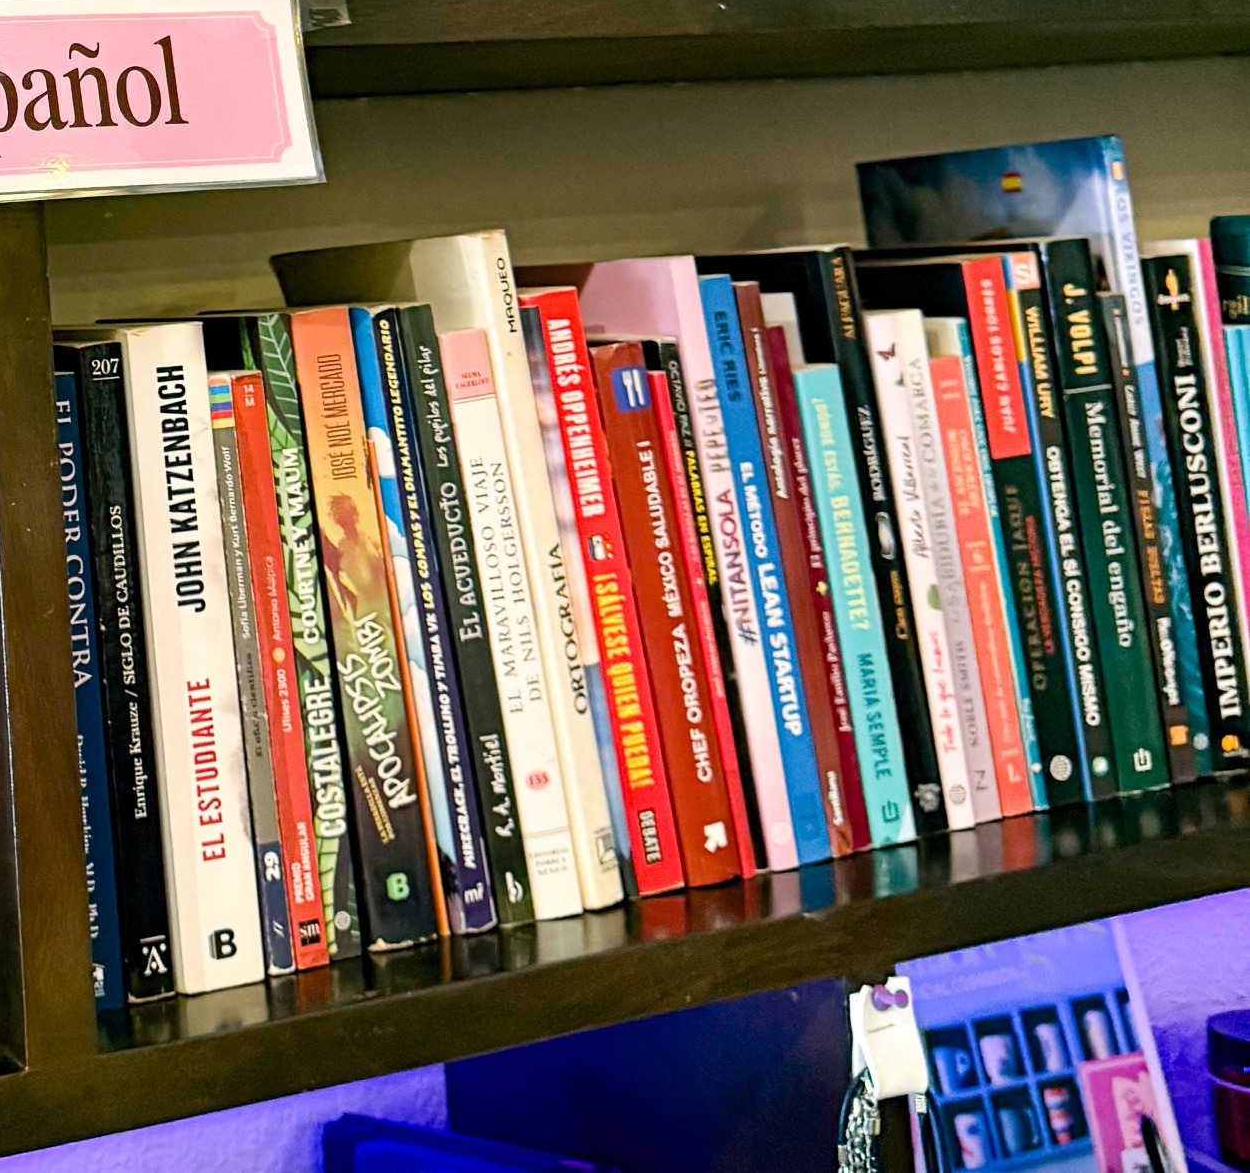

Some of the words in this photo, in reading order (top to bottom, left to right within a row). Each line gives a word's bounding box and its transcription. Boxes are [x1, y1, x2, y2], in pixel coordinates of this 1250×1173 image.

[91, 358, 120, 374] 207
[547, 319, 578, 387] ANDRÉS
[1067, 310, 1098, 375] VOLPI
[156, 365, 201, 535] KATZENBACH
[281, 448, 305, 515] MAUM
[561, 391, 606, 517] OPPENHEIMER
[1174, 374, 1222, 578] BERLUSCONI
[172, 540, 207, 613] JOHN
[293, 515, 319, 644] COURTNEY
[758, 564, 784, 628] LEAN
[769, 633, 801, 736] STARTUP
[858, 652, 877, 706] MARIA
[1204, 585, 1242, 720] IMPERIO
[187, 677, 223, 827] ESTUDIANTE
[304, 677, 347, 838] COSTALEGRE
[865, 704, 891, 779] SEMPLE
[201, 832, 226, 862] EL
